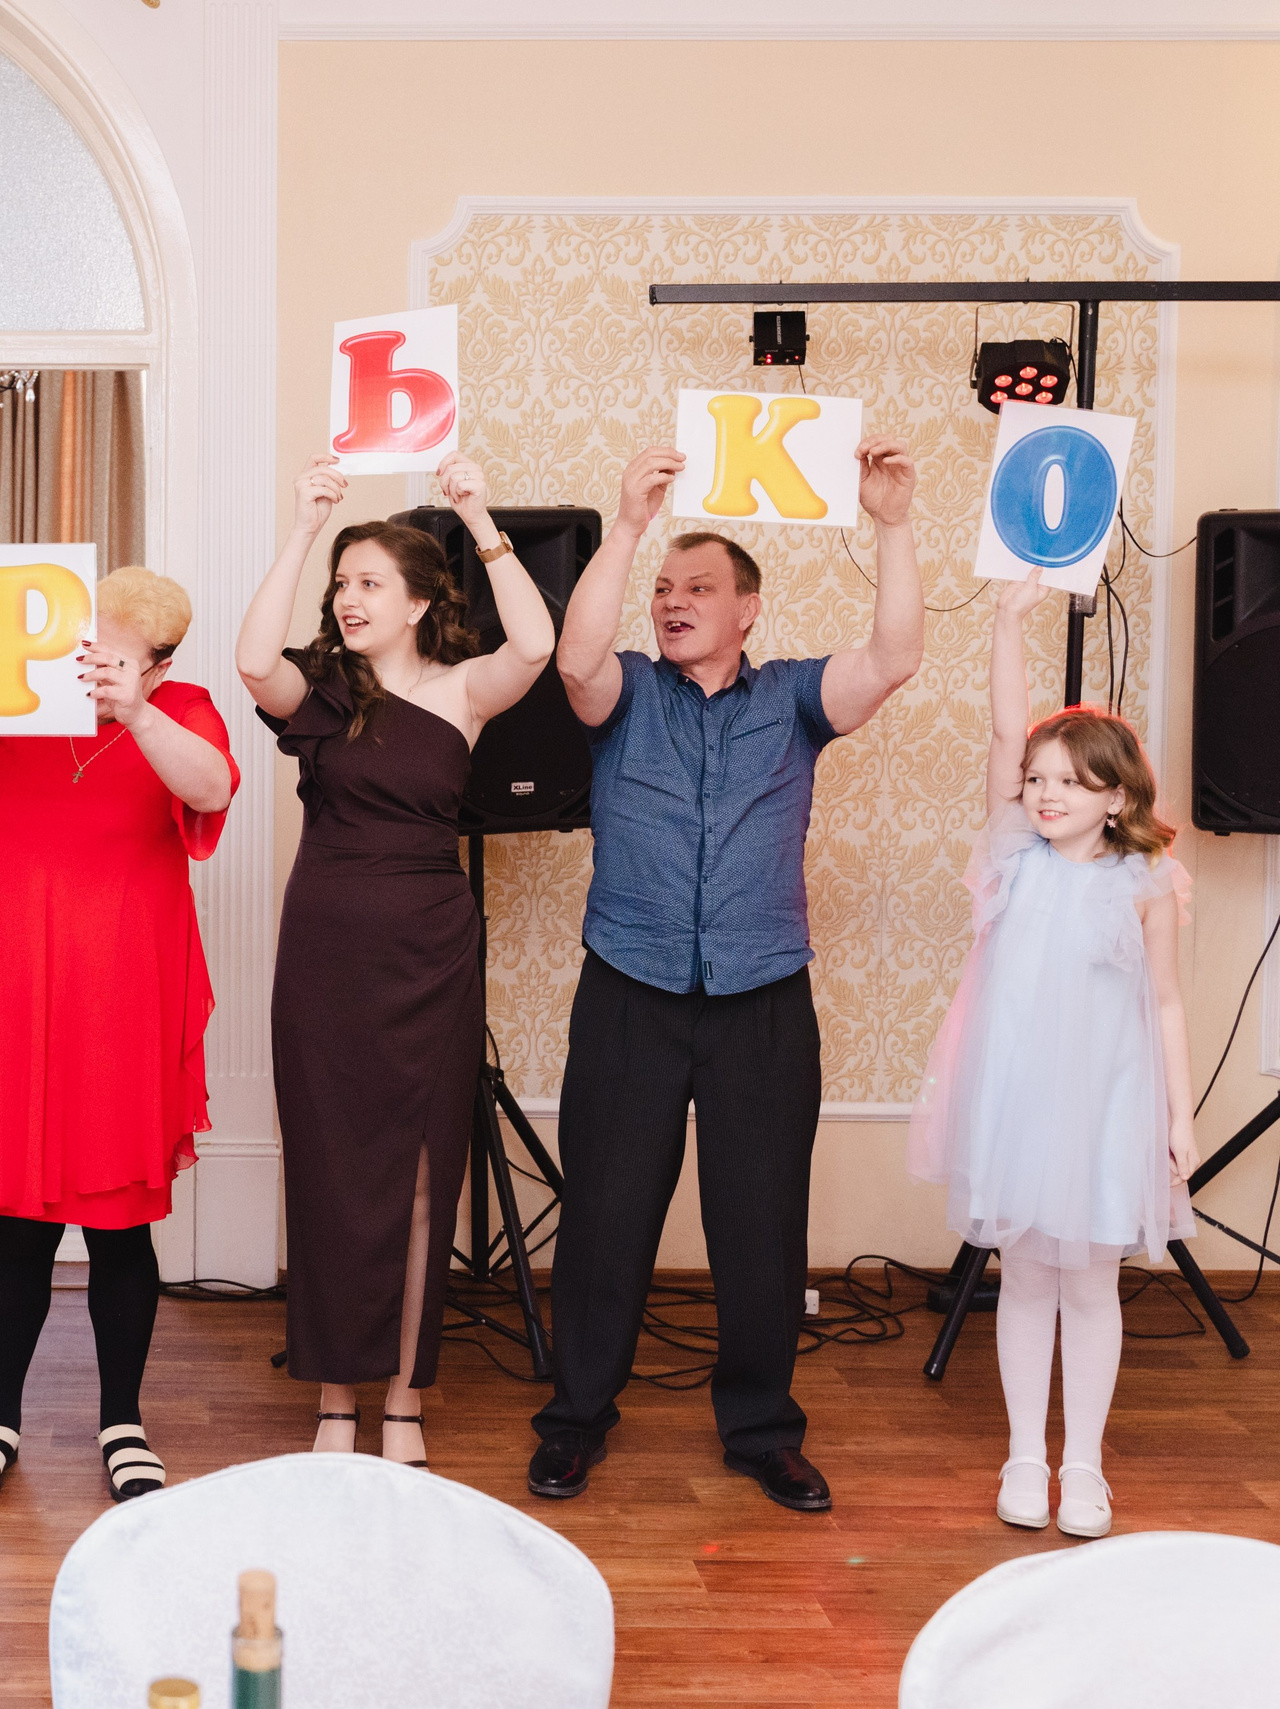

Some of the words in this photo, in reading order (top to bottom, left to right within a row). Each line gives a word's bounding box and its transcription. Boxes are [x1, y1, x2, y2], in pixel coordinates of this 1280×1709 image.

[332, 330, 456, 454] Ь
[702, 394, 829, 520] К
[990, 425, 1118, 569] О
